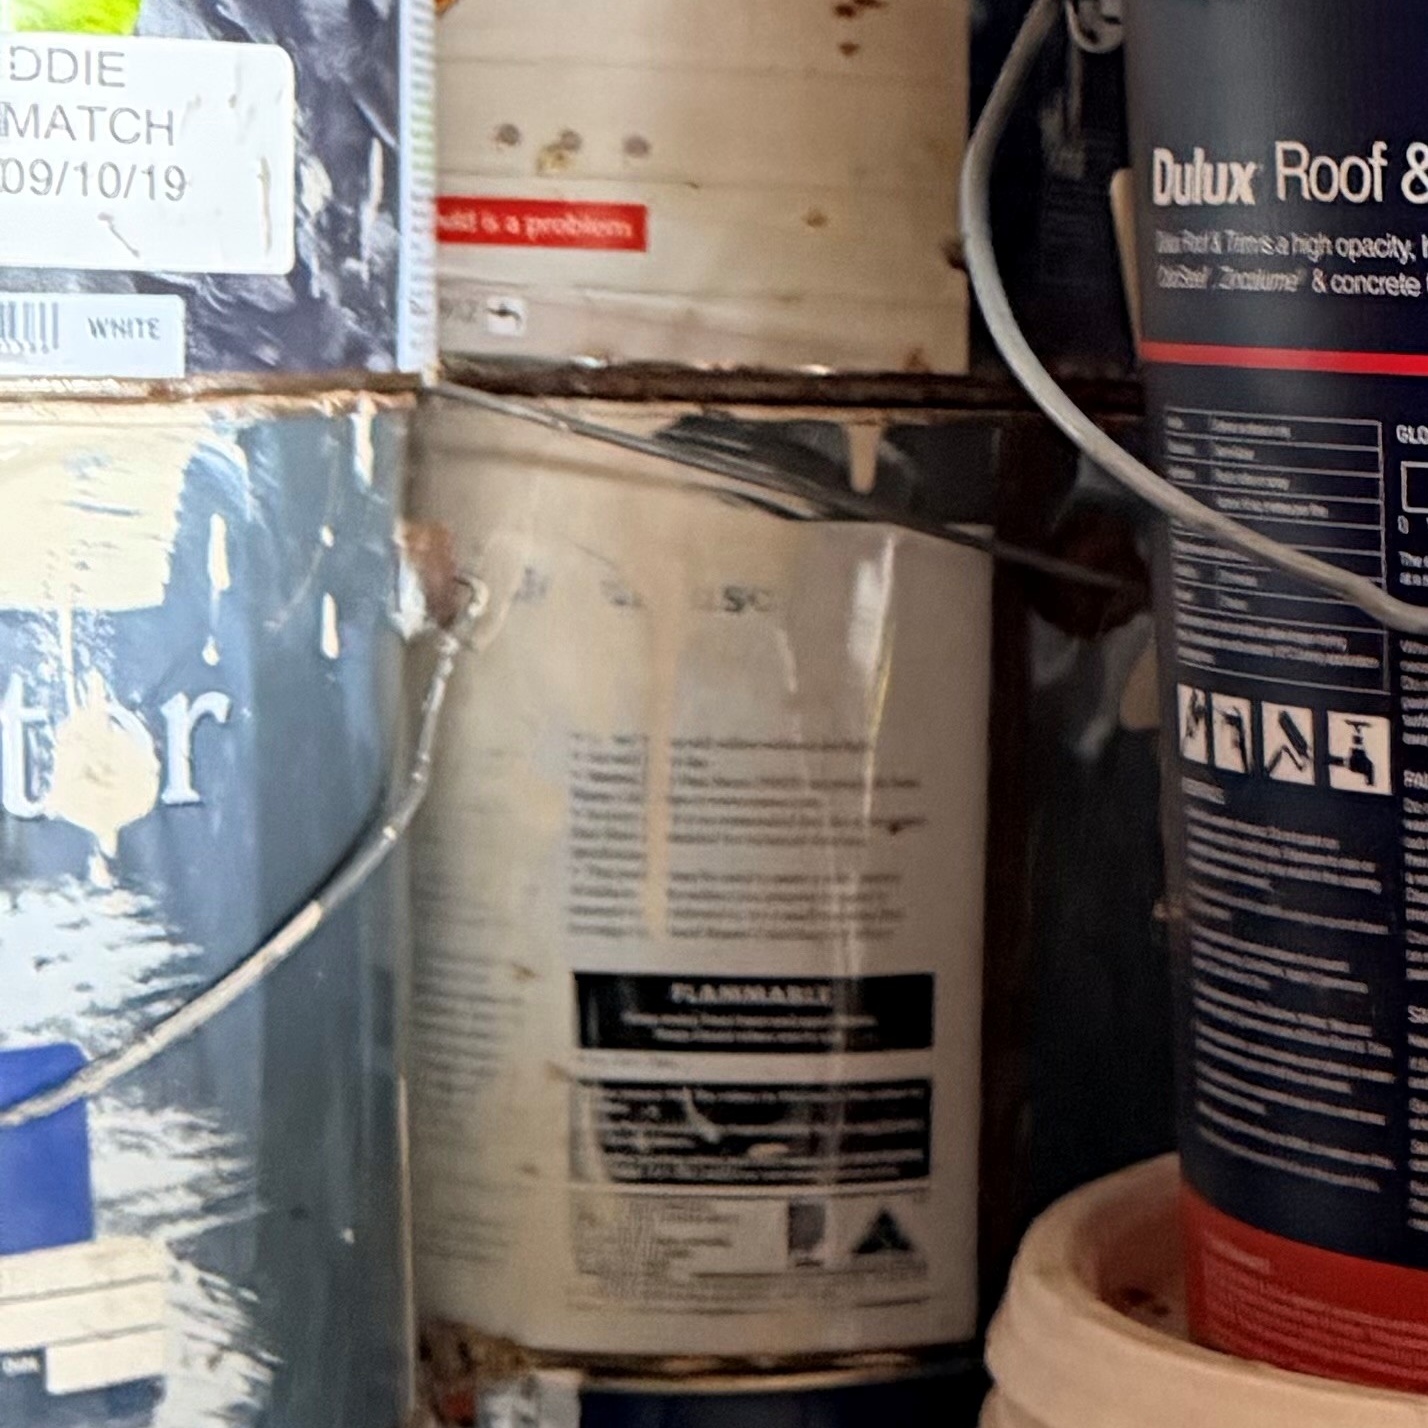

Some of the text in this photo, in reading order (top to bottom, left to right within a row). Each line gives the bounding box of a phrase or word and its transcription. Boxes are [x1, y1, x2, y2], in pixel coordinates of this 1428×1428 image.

[1152, 146, 1257, 207] Dulux
[1274, 140, 1388, 204] Roof
[526, 214, 634, 241] problem
[1291, 232, 1334, 264] high
[1334, 232, 1417, 266] opacity,
[1310, 267, 1328, 294] &
[1330, 271, 1422, 298] concrete
